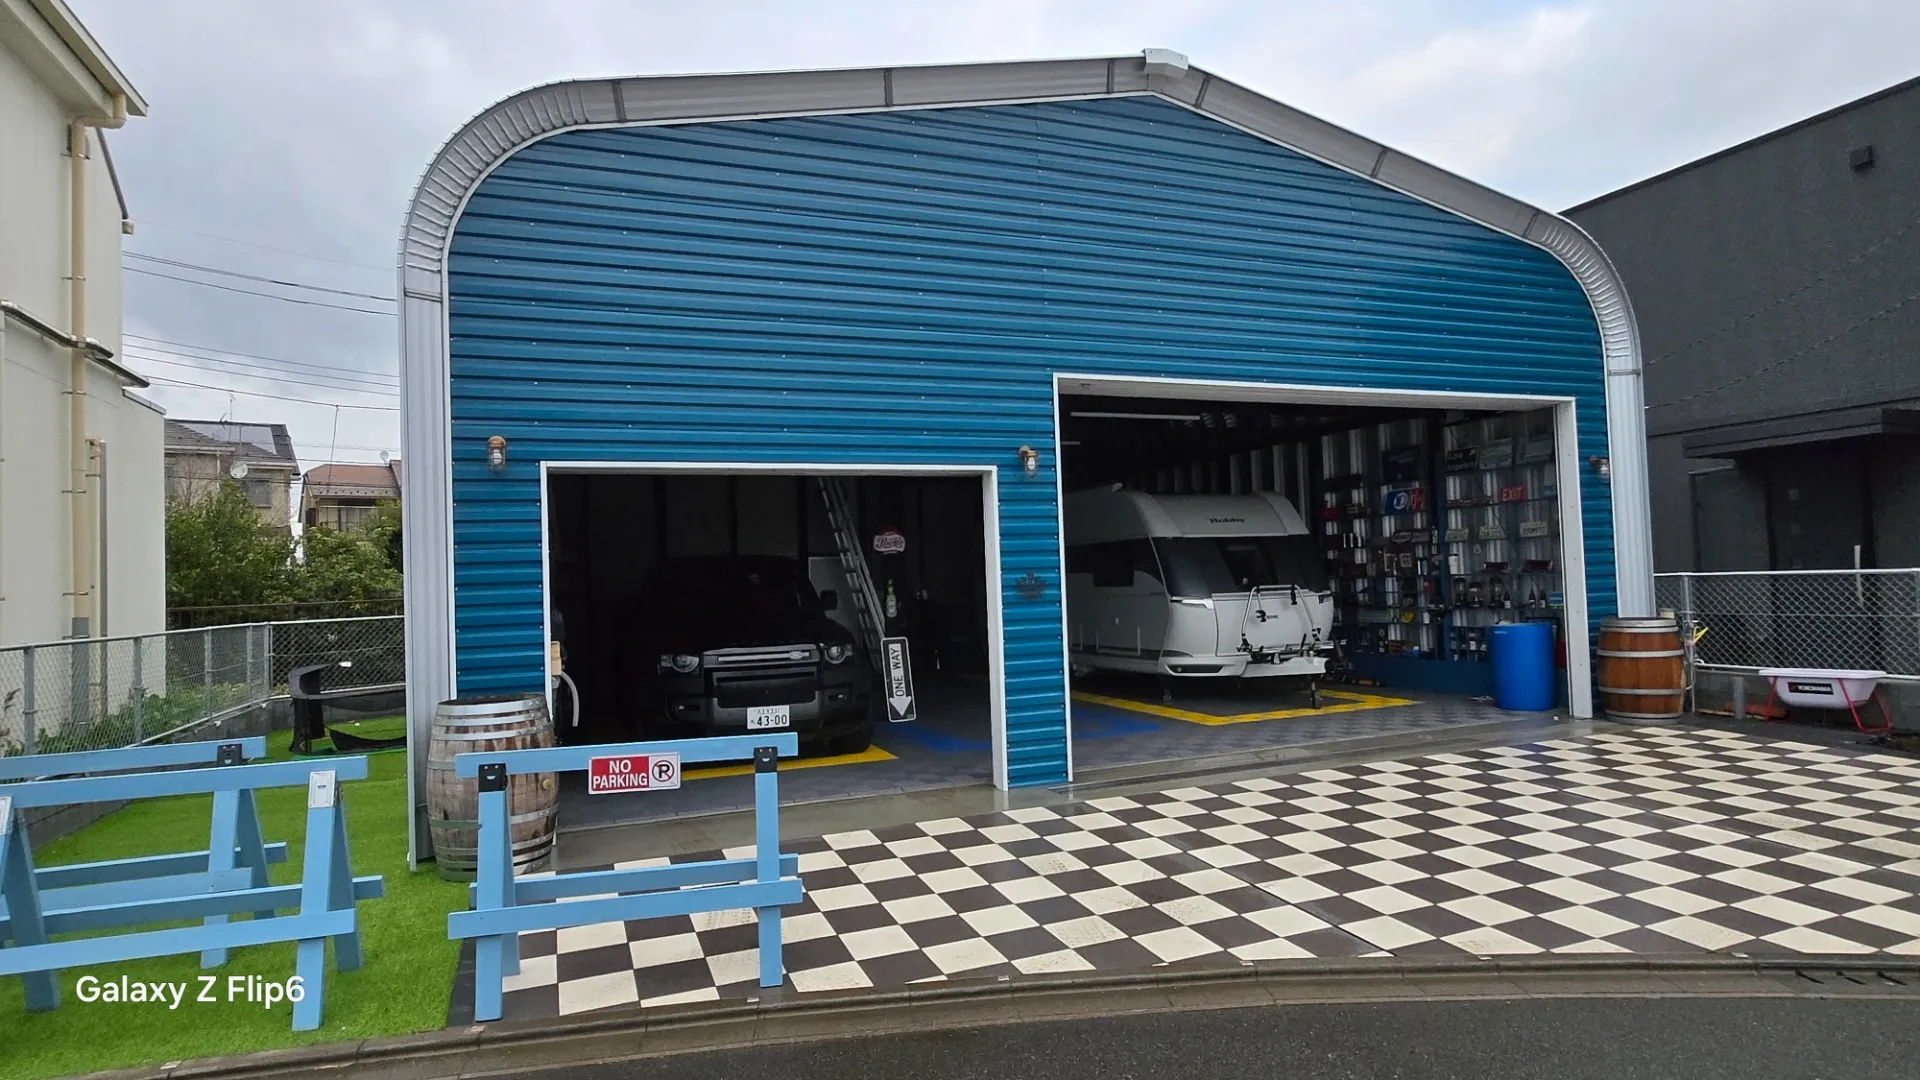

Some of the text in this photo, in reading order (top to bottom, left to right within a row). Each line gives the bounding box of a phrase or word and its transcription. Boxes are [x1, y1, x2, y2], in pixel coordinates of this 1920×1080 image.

[1502, 486, 1523, 502] EXIT
[890, 647, 905, 697] ONE WAY
[756, 713, 788, 727] 43-00
[609, 759, 632, 774] NO
[593, 773, 648, 789] PARKING
